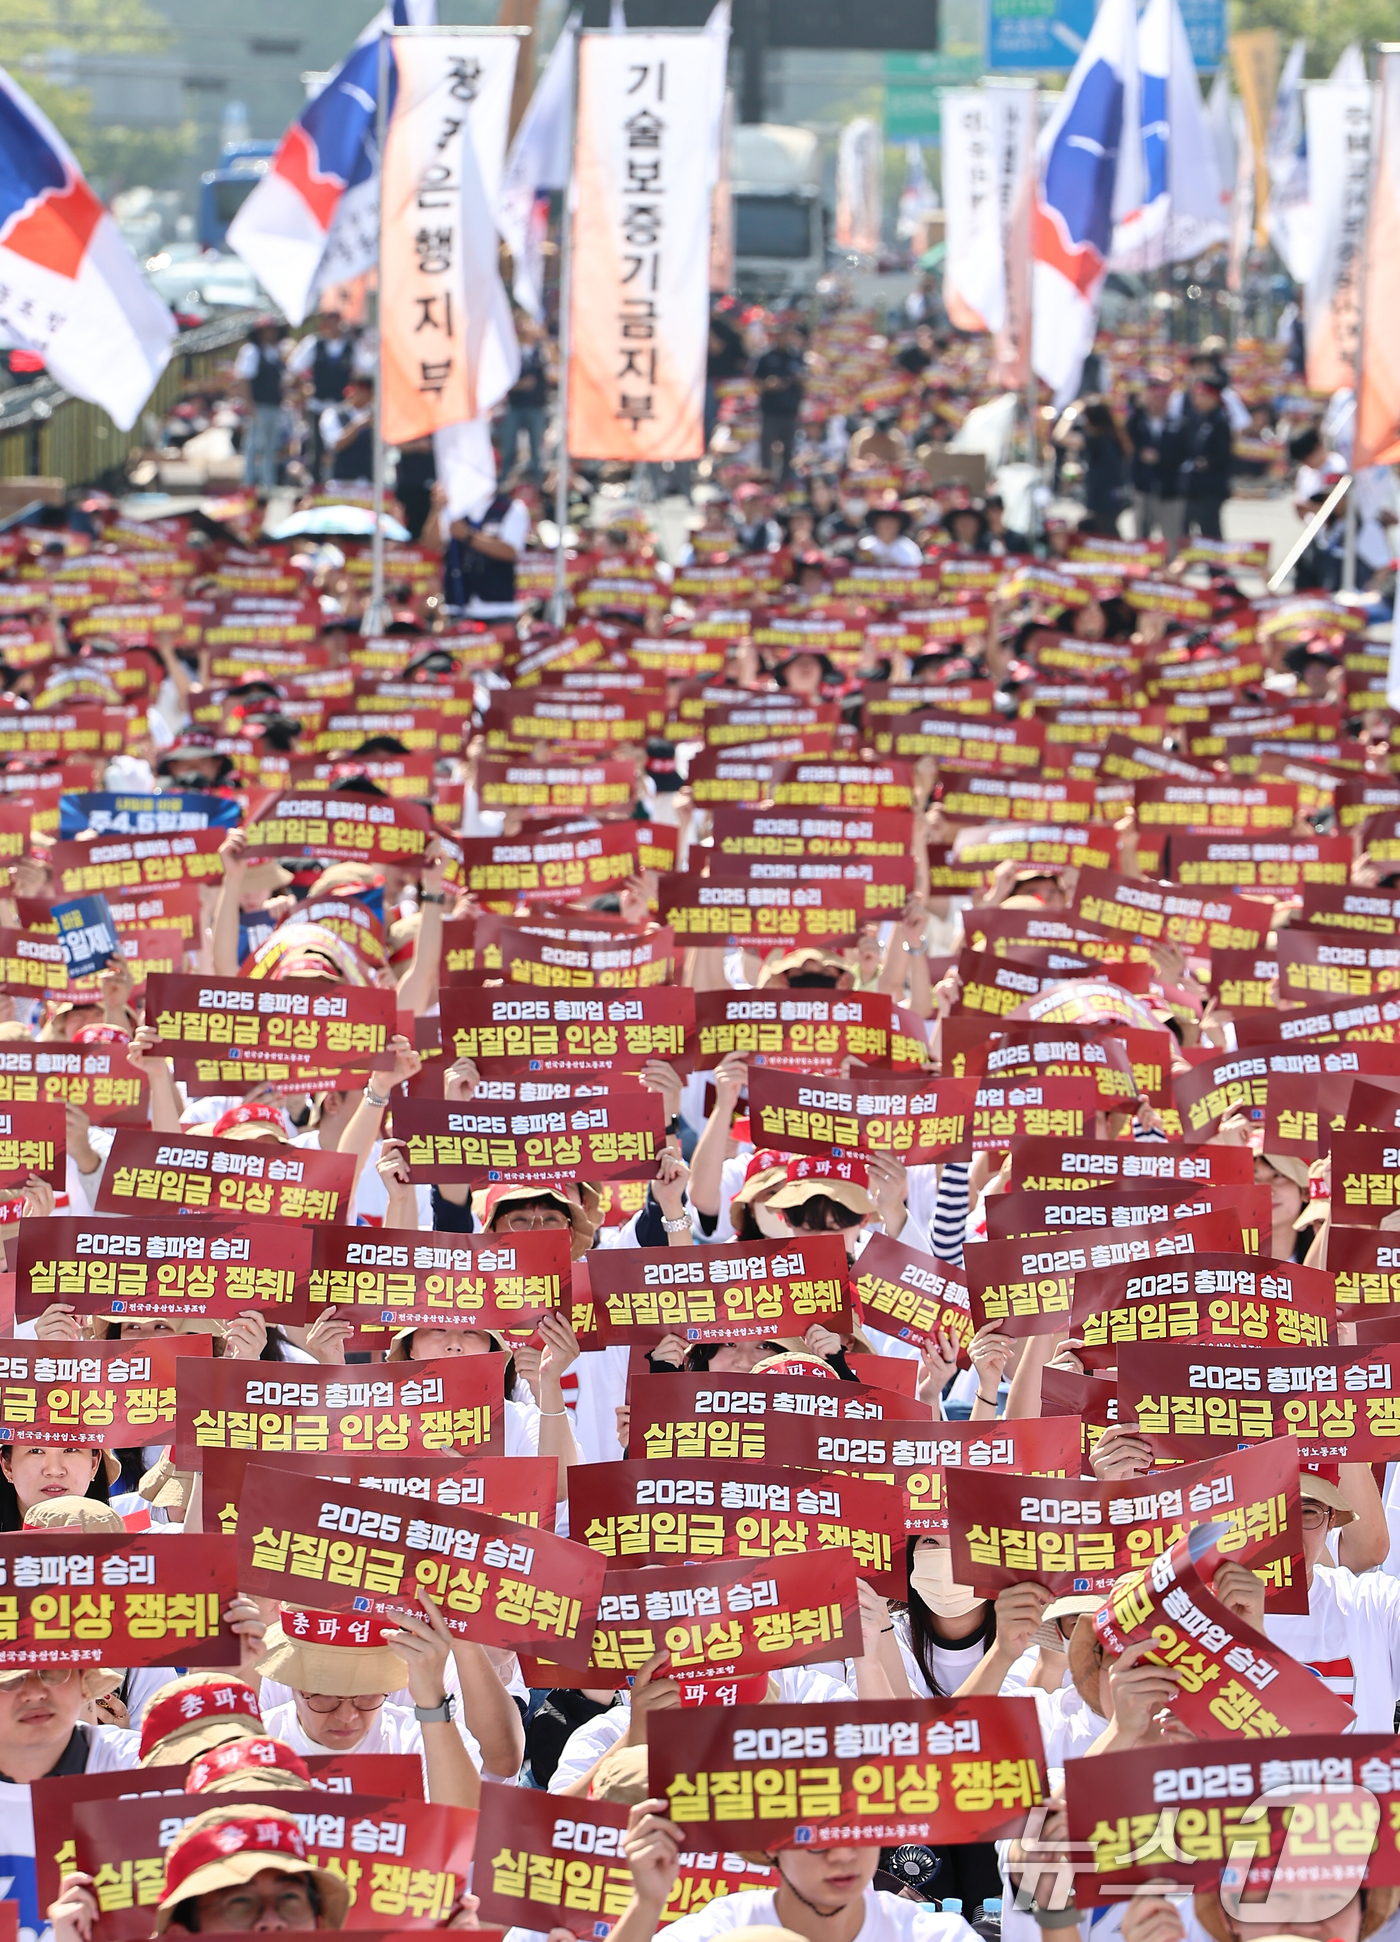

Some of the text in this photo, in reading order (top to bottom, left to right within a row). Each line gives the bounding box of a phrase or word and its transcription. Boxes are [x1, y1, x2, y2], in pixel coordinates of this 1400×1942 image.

[617, 62, 668, 428] 기술보증기금지부
[333, 821, 375, 848] 인상
[199, 989, 347, 1017] 2025 총파업 승리
[493, 1000, 643, 1020] 2025 총파업 승리
[727, 1001, 862, 1021] 2025 총파업 승리
[153, 1011, 385, 1053] 실질임금 인상 쟁취!
[453, 1025, 684, 1061] 실질임금 인상 쟁취!
[699, 1024, 886, 1057] 실질임금 인상 쟁취!
[799, 1088, 937, 1115] 2025 총파업 승리
[1008, 1088, 1042, 1105] 승리
[448, 1109, 608, 1134] 2025 총파업 승리
[760, 1105, 964, 1150] 실질임금 인상 쟁취!
[1023, 1109, 1083, 1136] 쟁취!
[155, 1147, 304, 1182] 2025 총파업 승리
[403, 1132, 654, 1166] 실질임금 인상 쟁취!
[1062, 1153, 1210, 1178] 2025 총파업 승리
[112, 1167, 338, 1220] 실질임금 인상 쟁취!
[1045, 1206, 1106, 1225] 2025
[76, 1234, 250, 1260] 2025 총파업 승리
[346, 1244, 515, 1271] 2025 총파업 승리
[1022, 1249, 1086, 1275] 2025
[29, 1261, 295, 1302] 실질임금 인상 쟁취!
[644, 1254, 805, 1284] 2025 총파업 승리
[900, 1264, 946, 1296] 2025
[1126, 1270, 1292, 1302] 2025 총파업 승리
[309, 1270, 560, 1309] 실질임금 인상 쟁취!
[605, 1280, 842, 1324] 실질임금 인상 쟁취!
[856, 1269, 945, 1336] 실질임금
[129, 1303, 206, 1313] 전국금융산업노동조합
[1078, 1300, 1269, 1348] 실질임금 인상
[703, 1325, 778, 1337] 전국금융산업노동조합
[34, 1357, 150, 1382] 총파업 승리
[1189, 1364, 1391, 1392] 2025 총파업 승리
[47, 1389, 117, 1425] 인상
[246, 1378, 443, 1408] 2025 총파업 승리
[695, 1391, 766, 1414] 2025
[193, 1406, 490, 1451] 실질임금 인상 쟁취!
[1130, 1395, 1357, 1439] 실질임금 인상
[17, 1431, 105, 1443] 전국금융산업노동조합
[818, 1437, 1013, 1465] 2025 총파업 승리
[437, 1478, 484, 1504] 승리
[637, 1480, 840, 1517] 2025 총파업 승리
[1021, 1475, 1234, 1524] 2025 총파업 승리
[318, 1503, 534, 1575] 2025 총파업 승리
[581, 1513, 808, 1557] 실질임금 인상
[965, 1525, 1115, 1572] 실질임금
[13, 1555, 154, 1586] 총파업 승리
[252, 1523, 581, 1639] 실질임금 인상 쟁취!
[30, 1594, 218, 1639] 인상 쟁취!
[645, 1580, 778, 1620] 총파업 승리
[293, 1612, 370, 1642] 총파업
[665, 1604, 843, 1667] 인상 쟁취!
[1159, 1582, 1279, 1694] 총파업 승리
[734, 1720, 980, 1760] 2025 총파업 승리
[667, 1759, 1048, 1822] 실질임금 인상 쟁취!
[1153, 1758, 1358, 1802] 2025 총파업
[351, 1819, 406, 1856] 승리
[370, 1863, 455, 1924] 쟁취!
